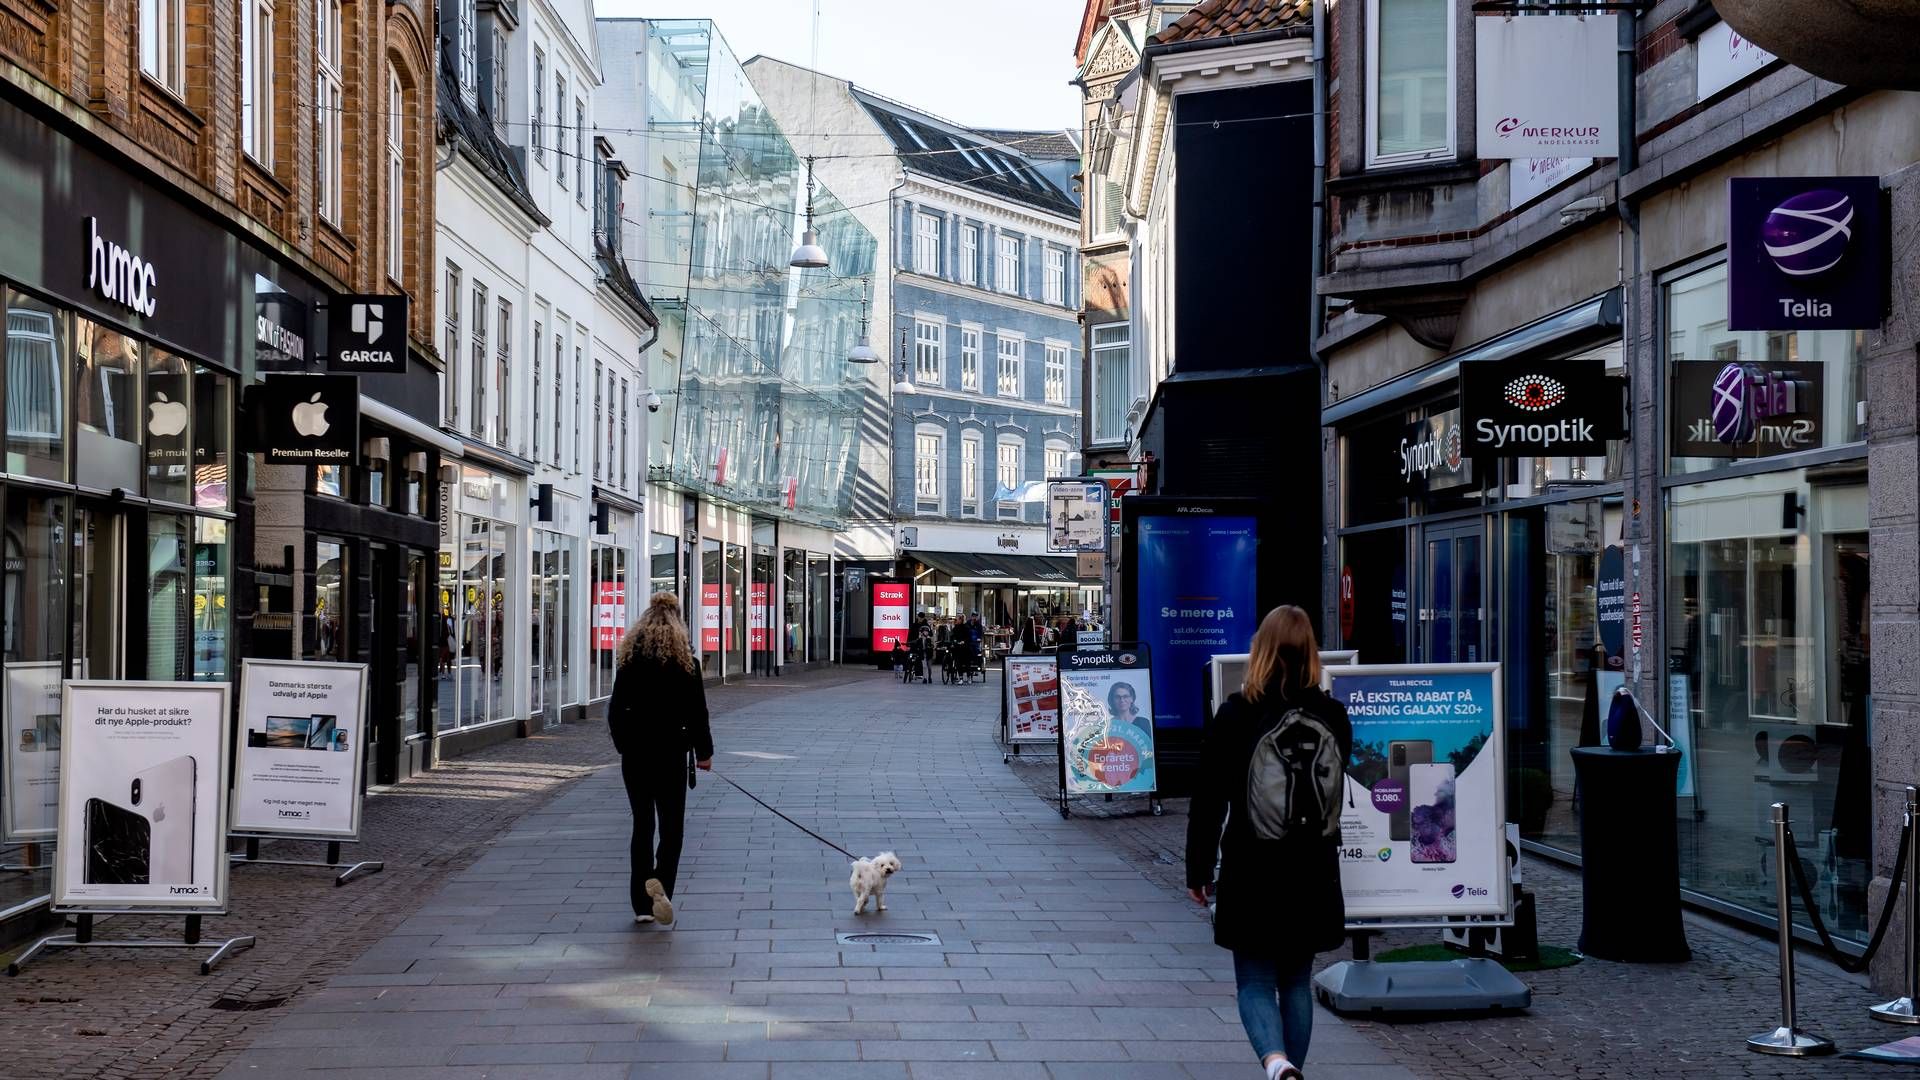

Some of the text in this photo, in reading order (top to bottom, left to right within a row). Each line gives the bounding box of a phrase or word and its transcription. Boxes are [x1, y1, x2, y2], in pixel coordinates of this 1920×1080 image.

[1522, 127, 1600, 138] MERKUR
[90, 216, 156, 318] humac
[1778, 298, 1832, 318] Telia
[340, 350, 394, 363] GARCIA
[1476, 417, 1595, 448] Synoptik
[272, 447, 350, 458] Premium Reseller
[1400, 430, 1442, 483] Synoptik
[440, 506, 448, 537] MODA
[880, 591, 904, 599] Stræk
[1161, 606, 1235, 621] Se mere på
[1071, 654, 1114, 665] Synoptik
[269, 681, 306, 689] Danmarks
[272, 690, 297, 699] udvalg
[1349, 688, 1473, 703] FÅ EKSTRA RABAT PÅ
[97, 707, 113, 715] Har
[114, 707, 126, 715] du
[127, 707, 157, 715] husket
[168, 708, 190, 716] sikre
[1345, 704, 1483, 716] AMSUNG GALAXY S20+
[94, 717, 193, 727] dit nye Apple-produkt?
[278, 809, 303, 817] humac
[169, 885, 199, 894] humac
[1466, 887, 1488, 896] Telia
